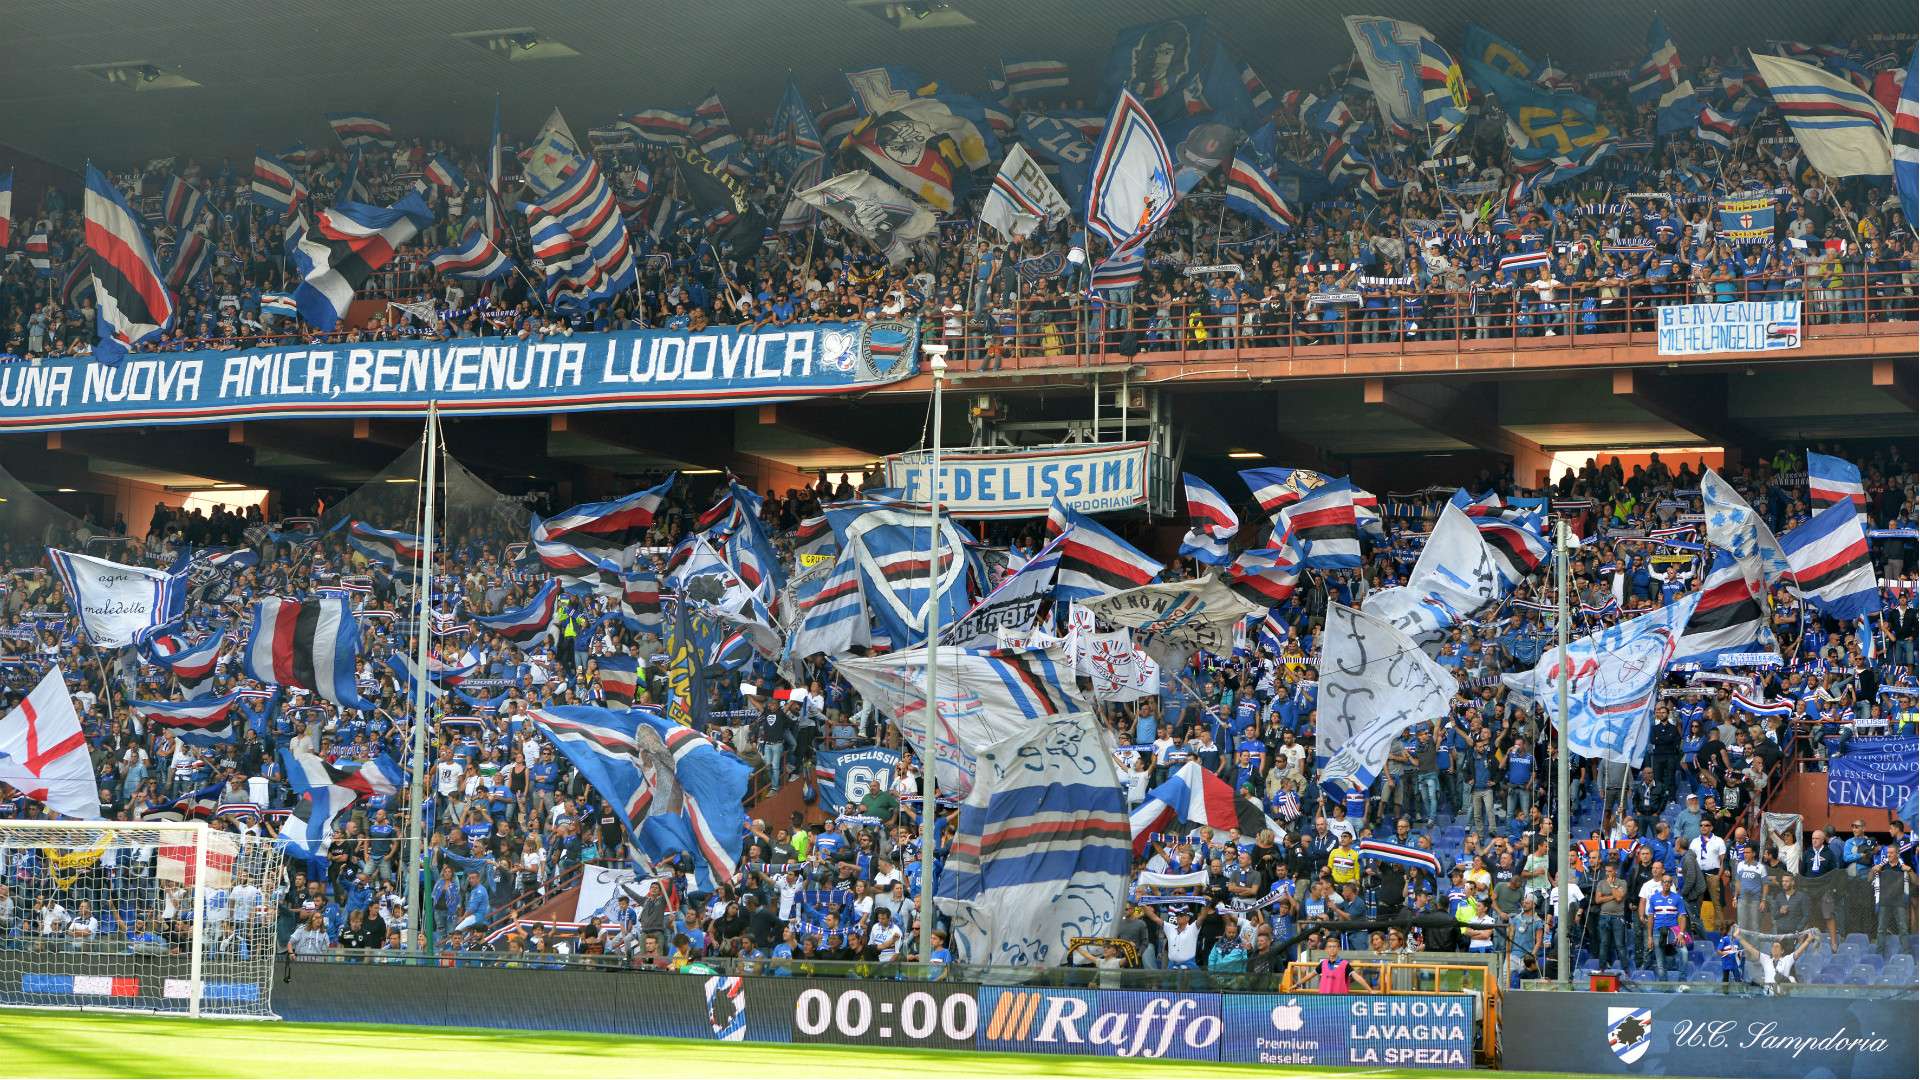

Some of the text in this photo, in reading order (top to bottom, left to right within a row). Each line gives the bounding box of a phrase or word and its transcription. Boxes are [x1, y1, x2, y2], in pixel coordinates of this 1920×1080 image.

[1663, 301, 1797, 325] BENVENUTO
[1660, 325, 1764, 351] MICHELANGELO
[0, 366, 73, 407] UNA
[82, 360, 203, 404] NUOVA
[603, 332, 815, 382] LUDOVICA
[906, 458, 1135, 500] FEDELISSIMI
[1065, 495, 1134, 511] MPDORIANI
[1126, 594, 1168, 614] NON
[845, 765, 889, 805] 61
[1844, 769, 1885, 782] ESSERCI
[1828, 779, 1913, 808] SEMPR
[1351, 1001, 1465, 1017] GENOVA
[796, 989, 1224, 1057] 00:00 Raffo
[1351, 1025, 1465, 1040] LAVAGNA
[1256, 1037, 1319, 1050] Premium
[1673, 1019, 1889, 1058] U.C. Sampdoria
[1260, 1053, 1314, 1064] Reseller
[1350, 1048, 1465, 1064] LA SPEZIA
